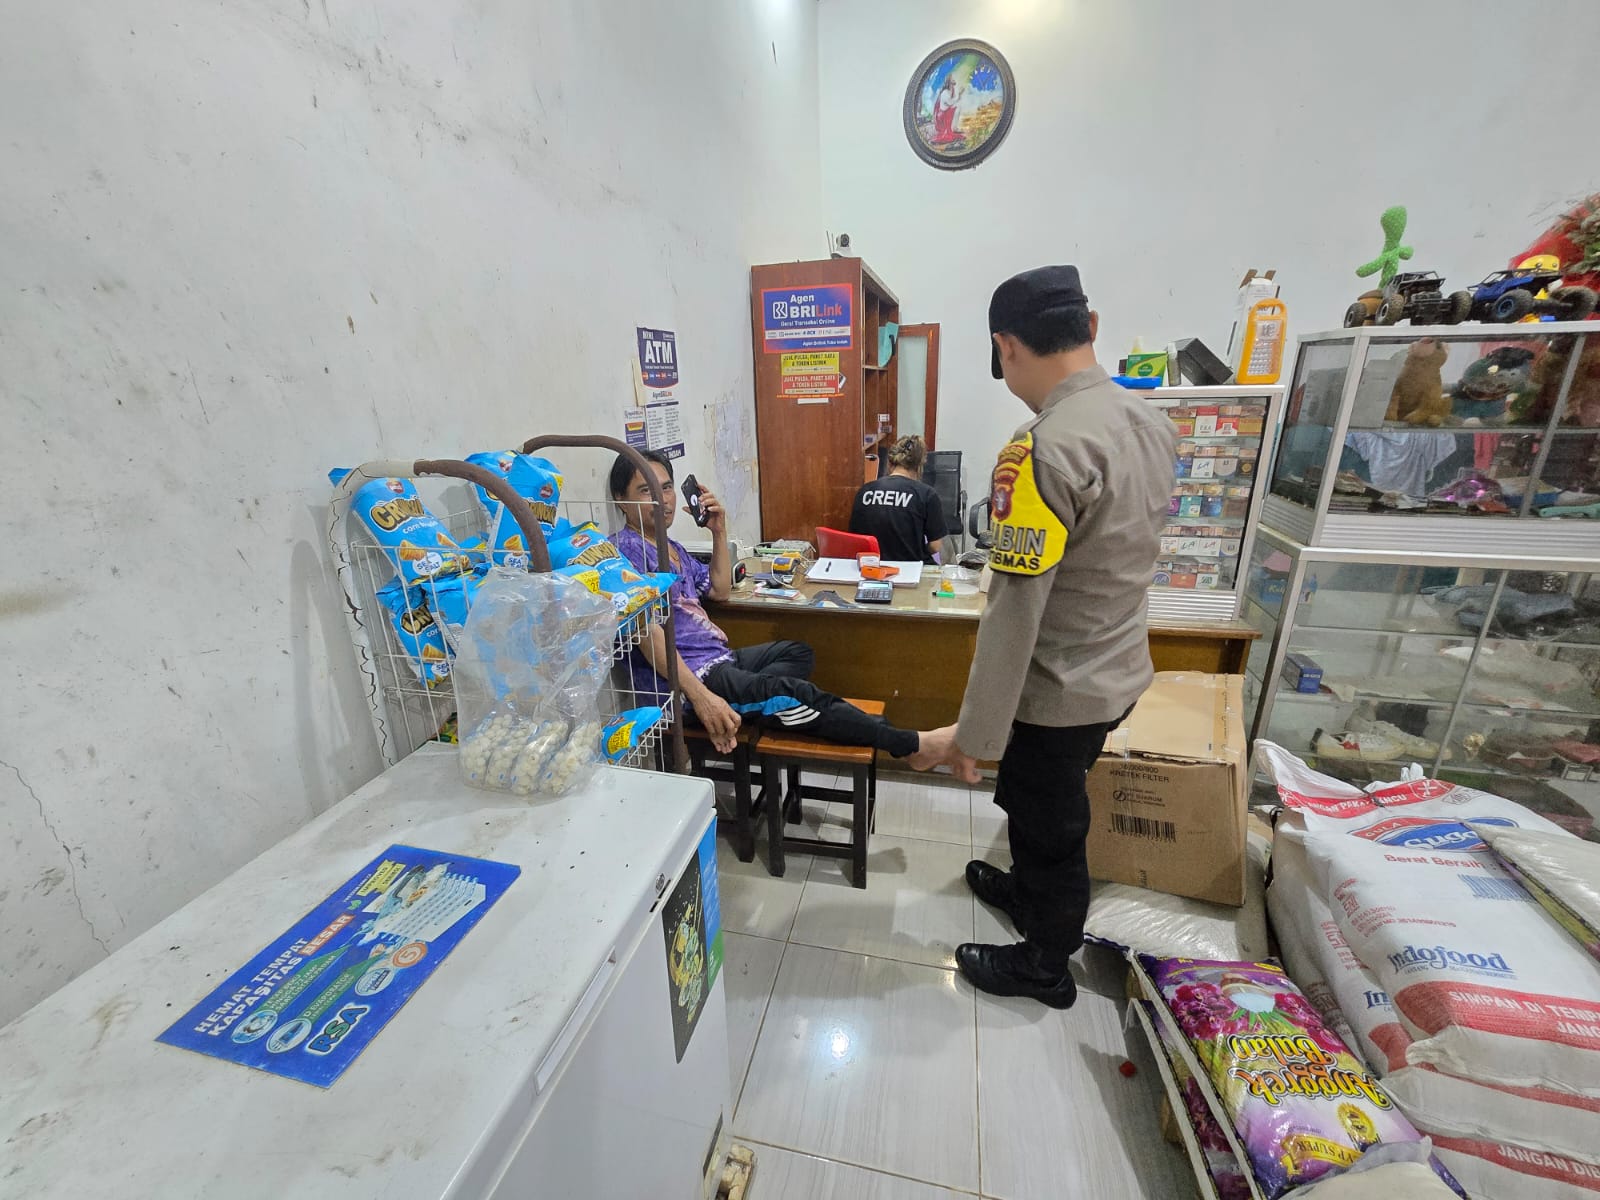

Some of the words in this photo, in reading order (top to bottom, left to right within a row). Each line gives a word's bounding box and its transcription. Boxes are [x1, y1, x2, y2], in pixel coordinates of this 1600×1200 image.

[790, 294, 815, 304] Agen
[790, 304, 842, 318] BRILink
[645, 341, 673, 363] ATM
[862, 490, 913, 508] CREW
[1142, 772, 1170, 783] FILTER
[1365, 821, 1402, 838] GULA
[1383, 852, 1429, 865] Berat
[1431, 856, 1484, 870] Bersih
[1387, 945, 1514, 975] Indofood
[194, 984, 253, 1034] HEMAT
[250, 937, 310, 984] TEMPAT
[207, 956, 303, 1037] KAPASITAS
[303, 914, 352, 956] BESAR
[1448, 990, 1523, 1011] SIMPAN
[1522, 1000, 1547, 1015] DI
[1545, 1004, 1600, 1023] TEMP
[308, 1006, 369, 1053] RSA
[1231, 1035, 1336, 1067] Bulan
[1233, 1061, 1392, 1109] Anggrek
[1497, 1143, 1570, 1173] JANGAN
